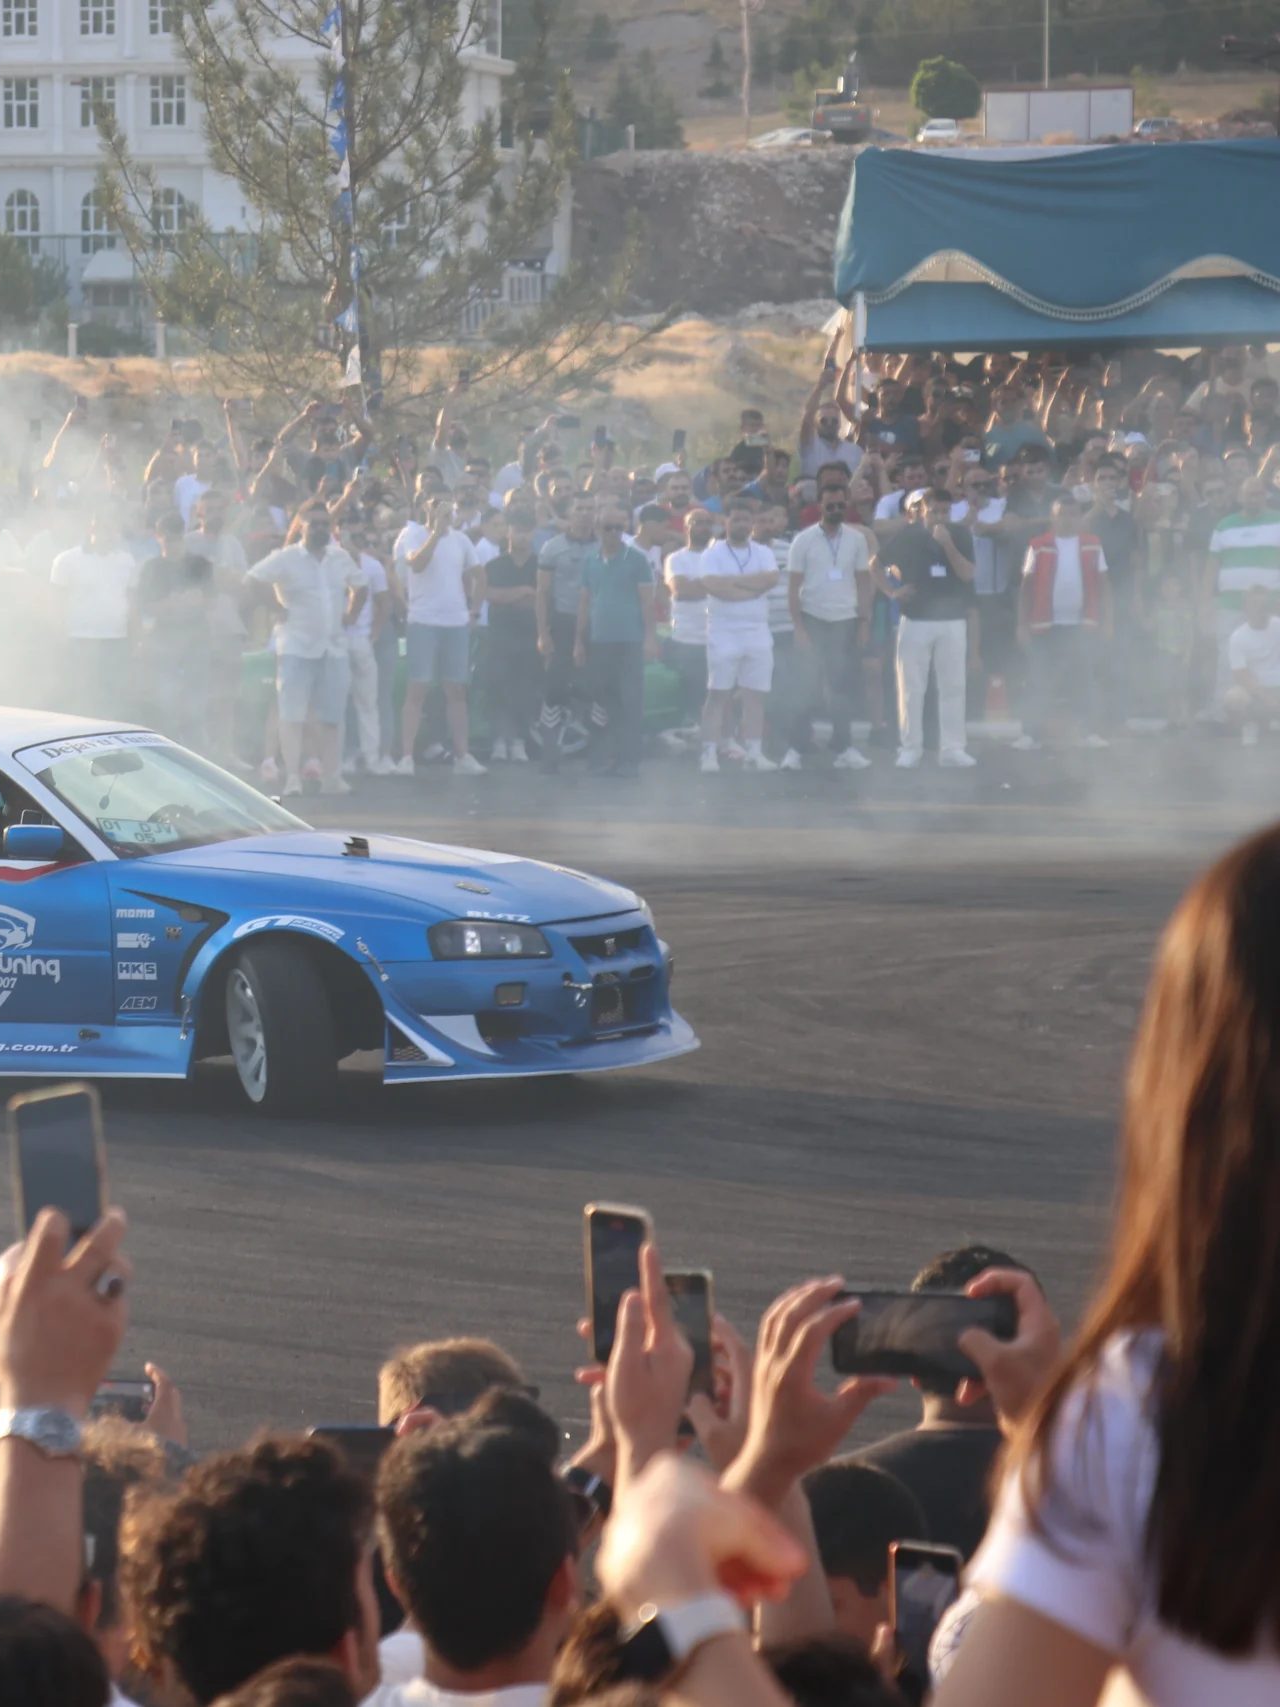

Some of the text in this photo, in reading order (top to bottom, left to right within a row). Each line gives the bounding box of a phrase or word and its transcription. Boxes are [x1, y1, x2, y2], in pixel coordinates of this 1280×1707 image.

[103, 819, 121, 831] 01
[134, 832, 156, 843] 05
[116, 908, 155, 918] momo
[118, 962, 157, 977] HKS
[119, 996, 157, 1010] AEM
